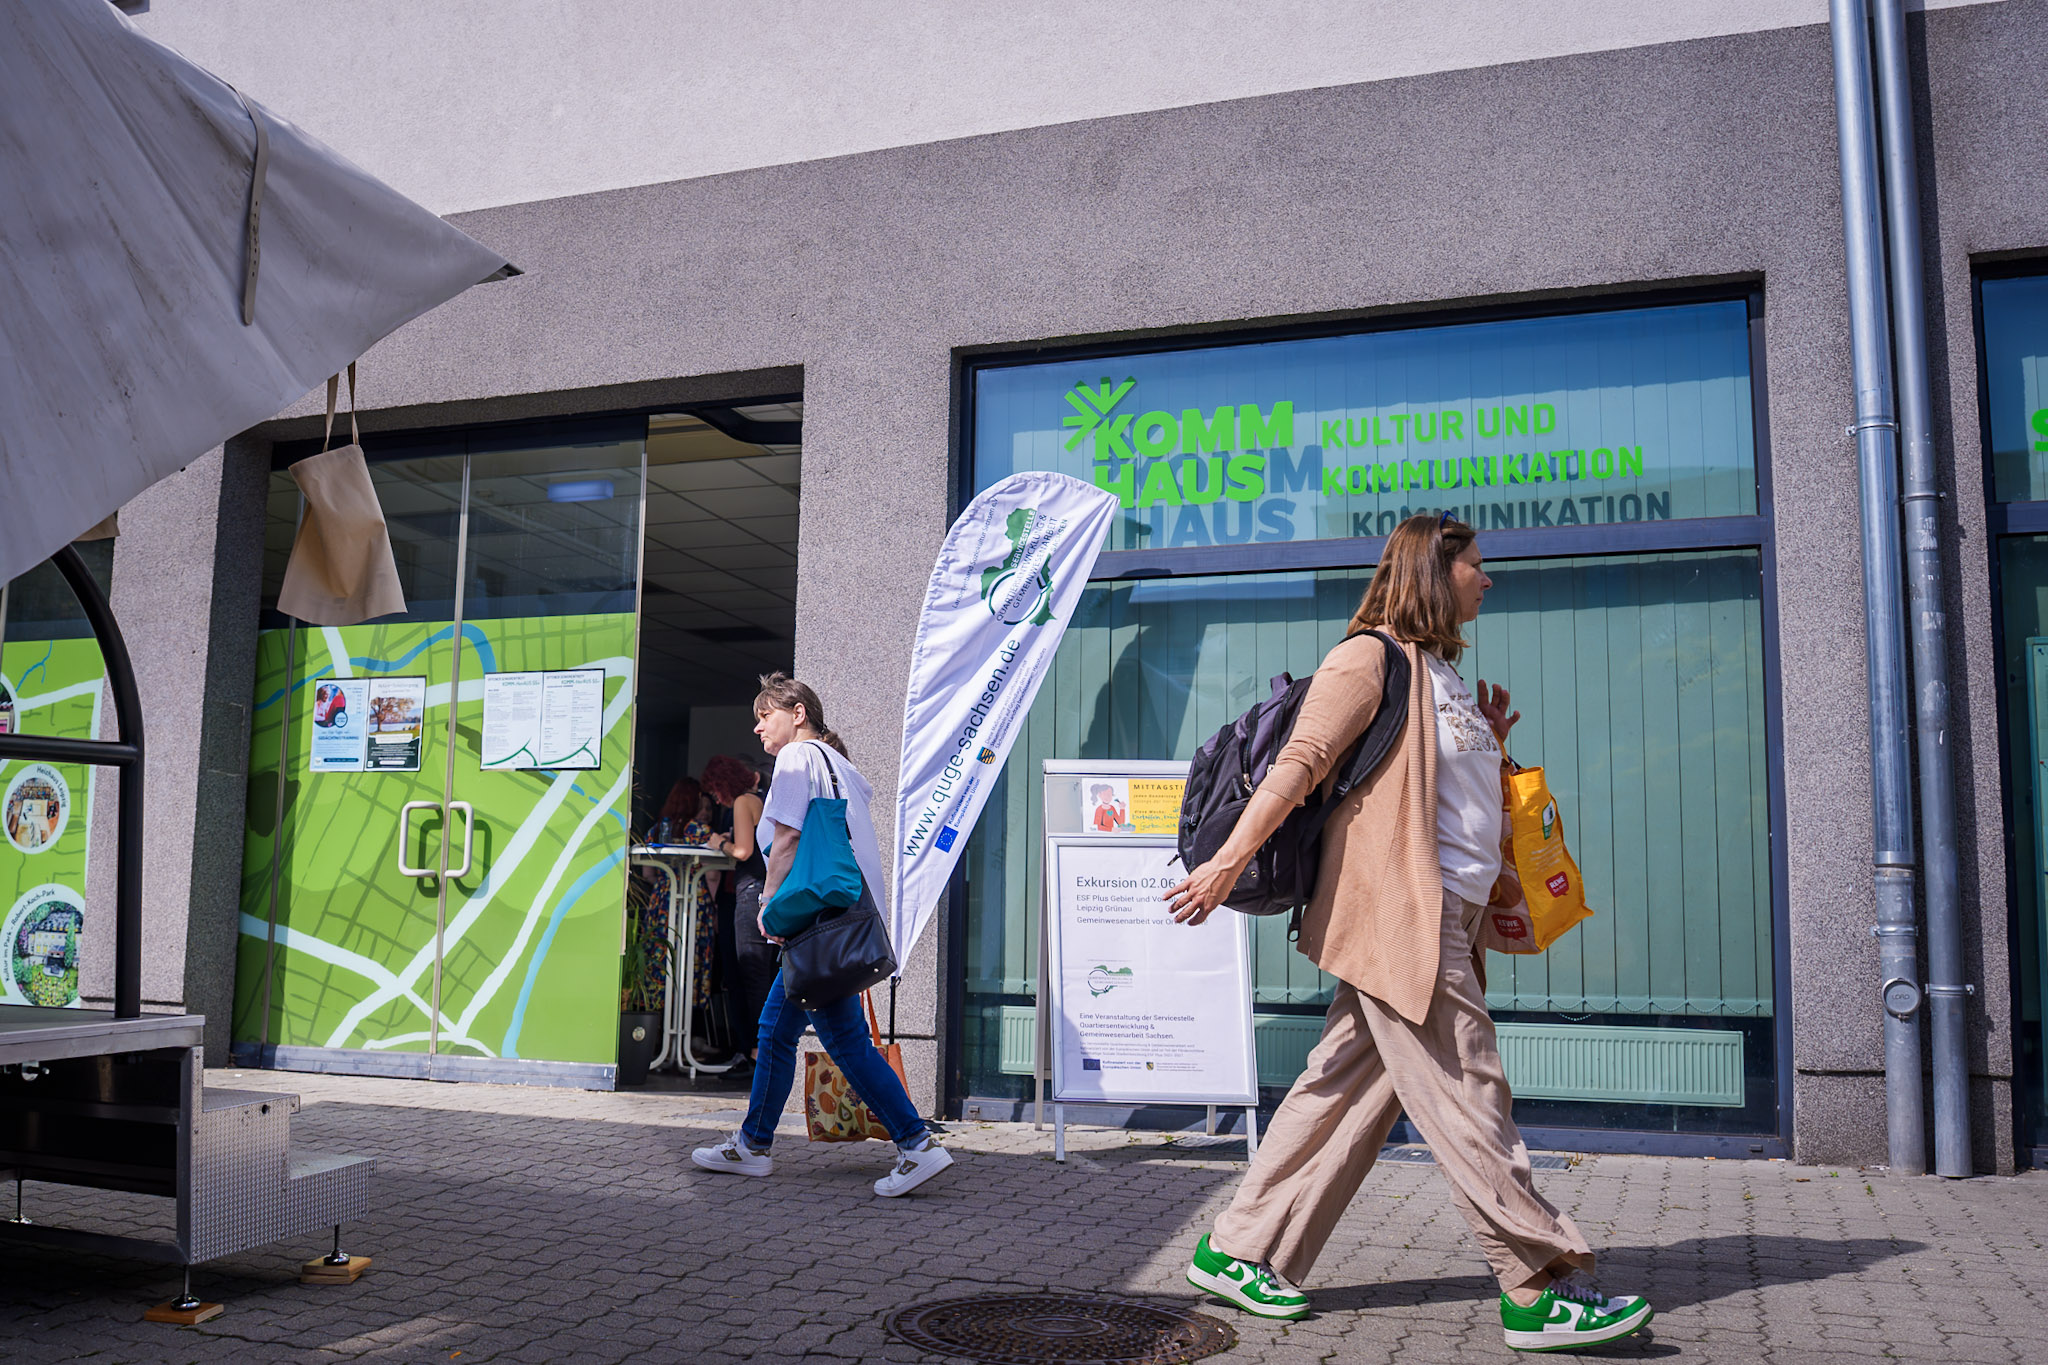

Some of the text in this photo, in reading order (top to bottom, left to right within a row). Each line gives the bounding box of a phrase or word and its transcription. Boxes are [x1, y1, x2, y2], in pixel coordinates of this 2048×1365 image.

[1094, 401, 1294, 461] KOMM
[1322, 403, 1556, 450] KULTUR UND
[1095, 454, 1267, 509] HAUS
[1322, 446, 1644, 497] KOMMUNIKATION
[1011, 510, 1036, 568] SERVICESTELLE
[996, 521, 1044, 621] QUARTIERSENTWICKLUNG
[1013, 517, 1058, 609] GEMEINWESENARBEIT
[903, 639, 1021, 857] www.quge-sachsen.de
[37, 766, 67, 808] Heizhaus Leipzig
[1076, 876, 1138, 888] Exkursion
[1076, 894, 1090, 902] ESF
[1110, 895, 1134, 903] Gebiet
[1076, 904, 1132, 912] Leipzig Grünau
[3, 931, 11, 948] Park
[1079, 1022, 1149, 1031] Quartiersentwicklung
[1079, 1031, 1144, 1039] Gemeinwesenarbeit
[1095, 1013, 1141, 1022] Veranstaltung
[1153, 1014, 1195, 1022] Servicestelle
